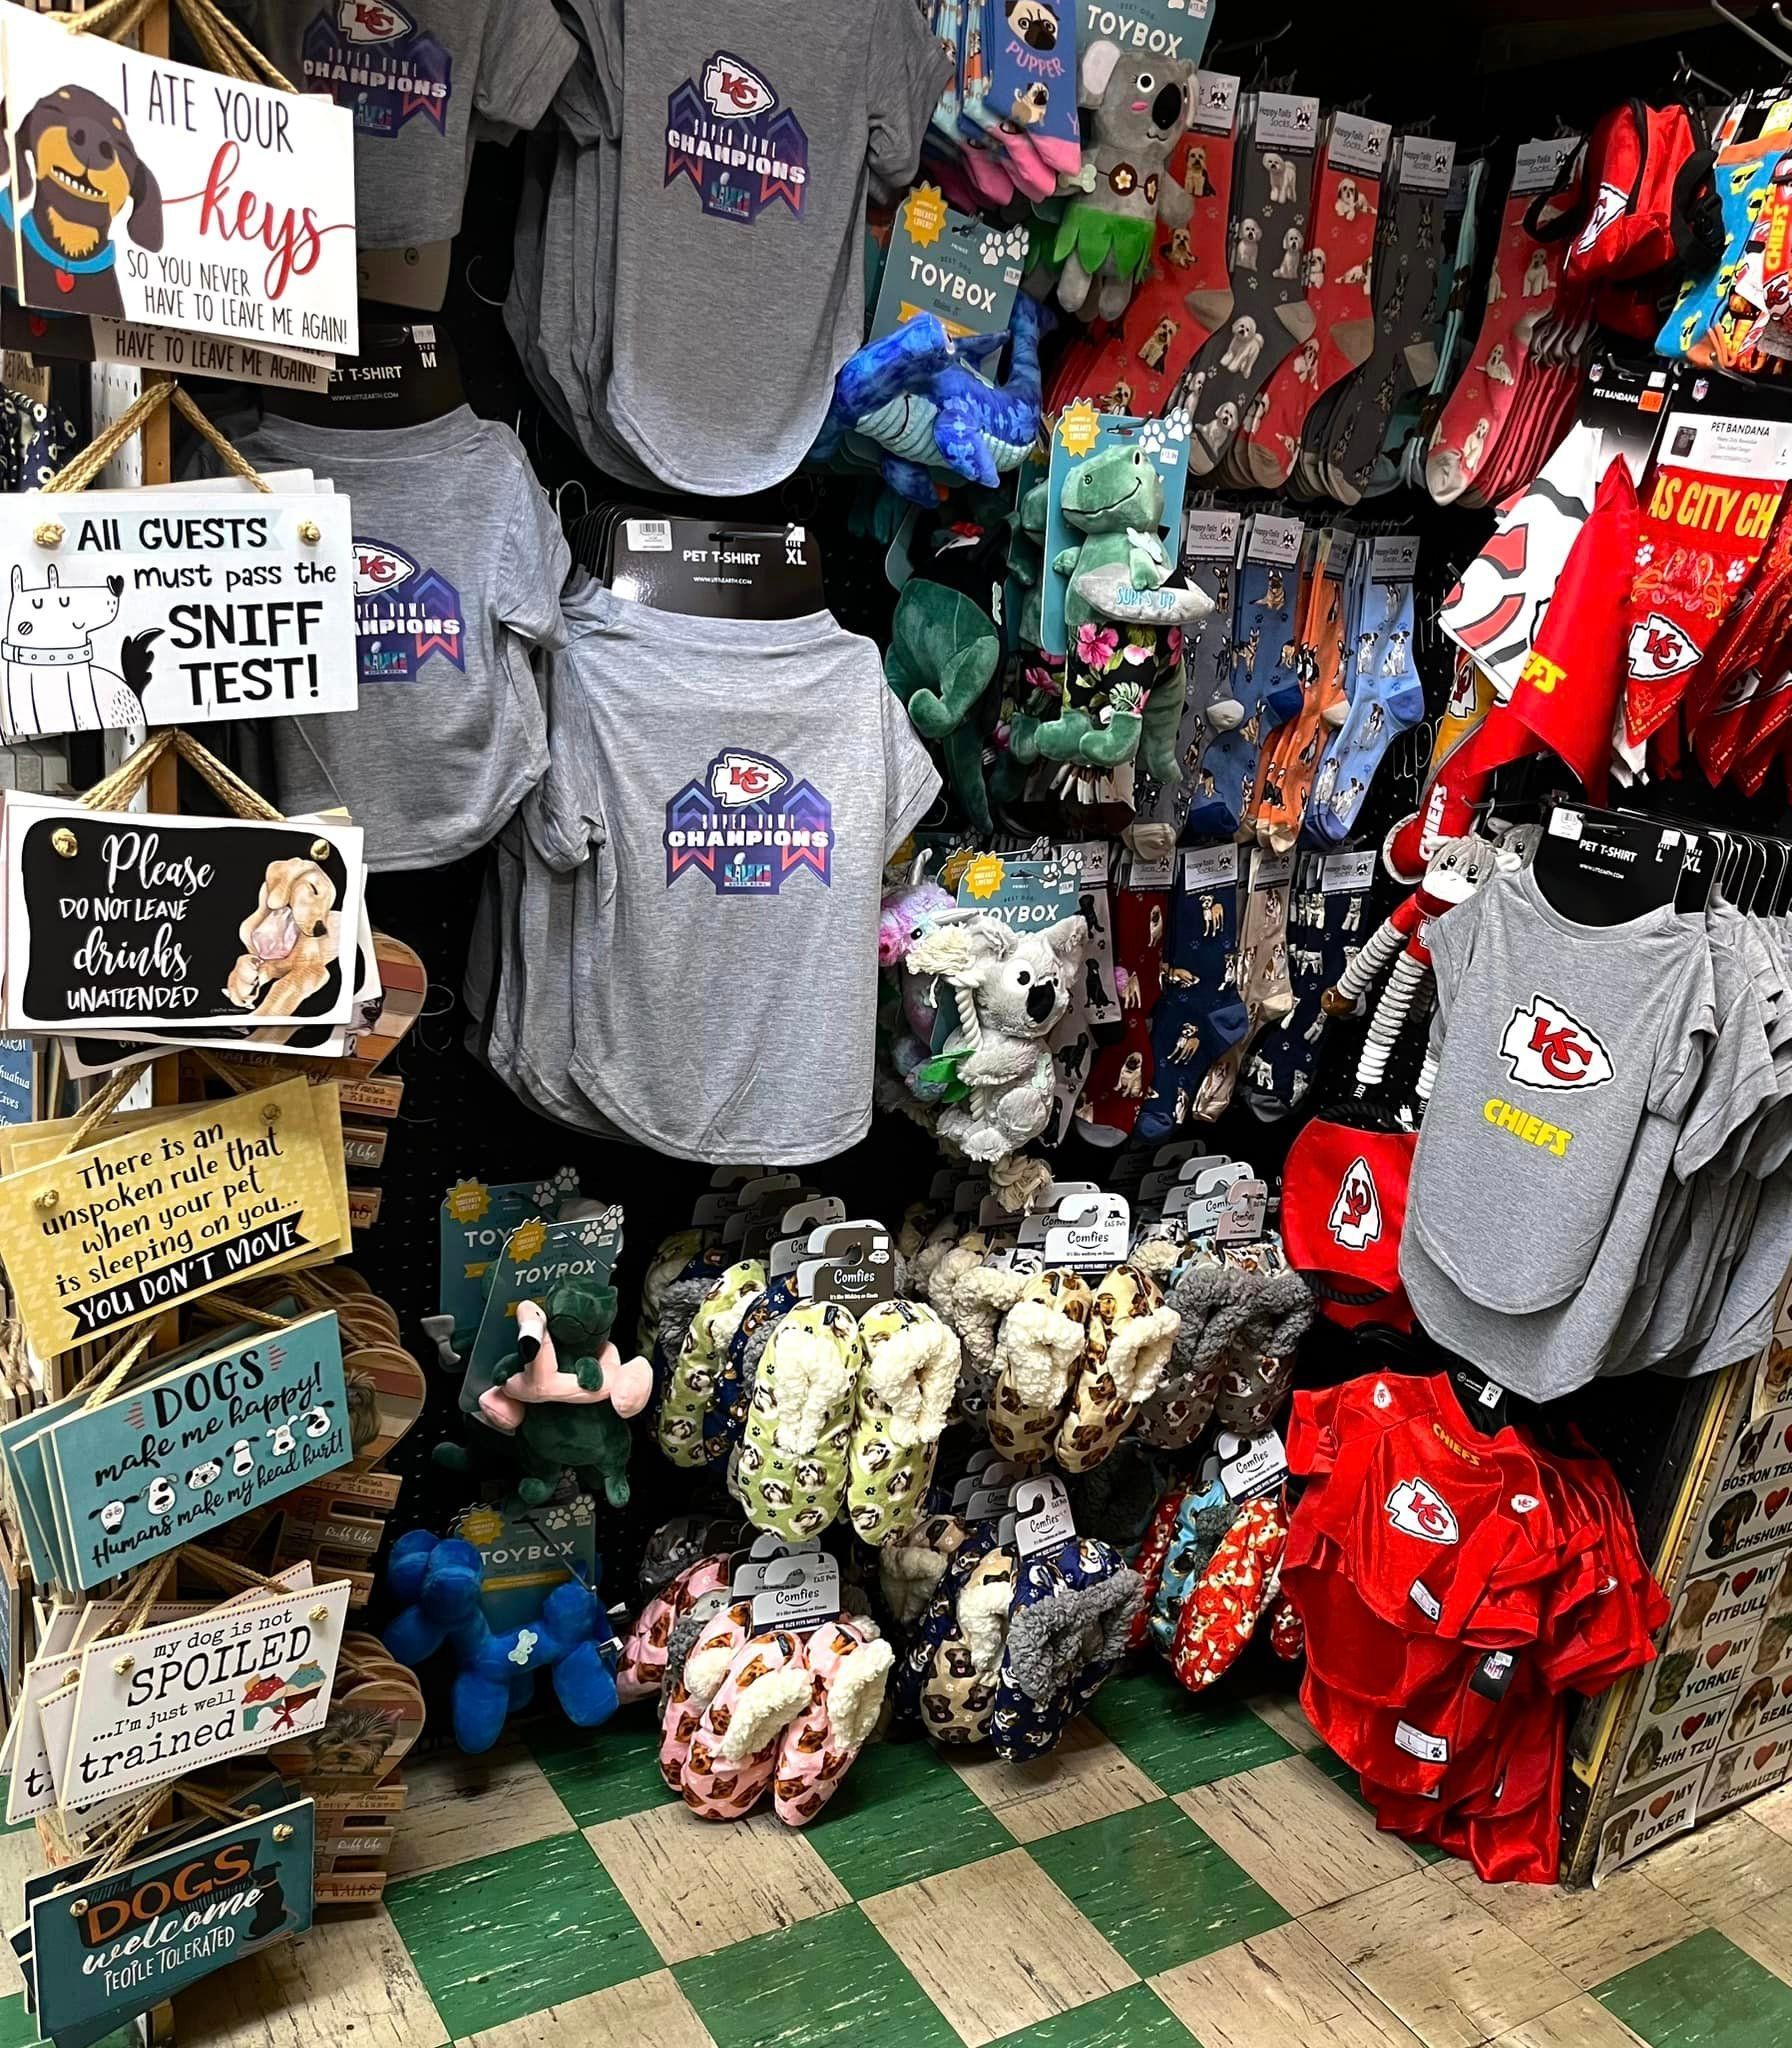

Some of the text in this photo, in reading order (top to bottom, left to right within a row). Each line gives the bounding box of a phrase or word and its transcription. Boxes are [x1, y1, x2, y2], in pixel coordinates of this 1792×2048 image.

[355, 3, 394, 35] KC
[1087, 5, 1183, 59] TOYBOX
[1005, 40, 1065, 77] PUPPER
[303, 60, 447, 98] CHAMPIONS
[720, 72, 758, 109] KC
[122, 63, 129, 116] I
[149, 70, 197, 132] ATE
[215, 87, 293, 153] YOUR
[668, 129, 806, 184] CHAMPIONS
[162, 140, 355, 300] keys
[128, 250, 251, 297] SO YOU NEVER
[910, 256, 997, 313] TOYBOX
[145, 286, 184, 319] HAVE
[193, 293, 214, 321] TO
[222, 297, 267, 331] LEAVE
[273, 306, 294, 336] ME
[302, 312, 348, 344] AGAIN!
[116, 330, 317, 384] HAVE TO LEAVE ME AGAIN!
[349, 366, 402, 381] T-SHIRT
[421, 352, 437, 368] M
[1593, 388, 1604, 398] PET
[1711, 422, 1770, 436] PET BANDANA
[1649, 475, 1783, 539] AS CITY CH
[77, 517, 267, 551] All GUESTS
[359, 556, 396, 583] KC
[683, 550, 760, 566] PET T-SHIRT
[785, 549, 806, 565] XL
[134, 561, 336, 592] must pass the
[1158, 592, 1175, 609] UP
[168, 600, 323, 649] SNIFF
[354, 619, 460, 636] MPIONS
[1644, 629, 1682, 670] KC
[179, 653, 319, 706] TEST!
[730, 767, 768, 793] KC
[668, 831, 829, 847] CHAMPIONS
[1579, 839, 1637, 863] PET T-SHIRT
[1656, 849, 1663, 862] L
[102, 832, 215, 896] Please
[1682, 856, 1700, 872] XL
[59, 896, 190, 921] DO NOT LEAVE
[978, 904, 1059, 922] TOYBOX
[73, 923, 192, 982] drinks
[66, 985, 199, 1011] UNATTENDED
[1528, 1017, 1592, 1081] KC
[1484, 1099, 1574, 1157] CHIEFS
[76, 1124, 224, 1191] There is an
[42, 1127, 283, 1237] unspoken rule that
[82, 1165, 265, 1256] when your pet
[1342, 1178, 1372, 1228] KC
[55, 1197, 299, 1297] is sleeping on you...
[464, 1228, 512, 1248] TOY
[1068, 1231, 1109, 1244] Comfies
[78, 1221, 298, 1328] YOU DON'T MOVE
[834, 1269, 875, 1284] Comfies
[153, 1350, 264, 1430] DOGS
[1487, 1393, 1494, 1401] S
[96, 1362, 323, 1486] make me happy!
[1773, 1432, 1782, 1449] I
[1236, 1451, 1268, 1473] Comfies
[1433, 1424, 1480, 1466] CHIEFS
[1721, 1463, 1792, 1492] BOSTON TER
[92, 1429, 344, 1568] Humans make my head hurt!
[1409, 1492, 1448, 1535] KC
[1755, 1501, 1762, 1517] I
[1030, 1515, 1060, 1533] Comfies
[480, 1541, 576, 1566] TOYBOX
[776, 1588, 819, 1604] Comfies
[1722, 1565, 1779, 1596] I MY
[1706, 1595, 1767, 1627] PITBULL
[153, 1608, 293, 1659] my dog is not
[127, 1625, 312, 1707] SPOILED
[1696, 1637, 1752, 1668] I MY
[1685, 1665, 1742, 1698] YORKIE
[1773, 1684, 1780, 1697] I
[92, 1689, 237, 1743] ...I'm just well
[1672, 1709, 1727, 1740] I MY
[1759, 1703, 1792, 1725] BEA
[79, 1711, 236, 1784] trained
[1652, 1736, 1718, 1771] SHIH TZU
[1744, 1740, 1792, 1771] I MY
[1639, 1781, 1696, 1822] I MY
[1720, 1767, 1786, 1803] SCHNAUZER
[1632, 1807, 1687, 1848] BOXER
[86, 1844, 251, 1946] DOGS
[81, 1887, 264, 1975] welcome
[103, 1926, 235, 1997] PEOPLE TOLERATED
